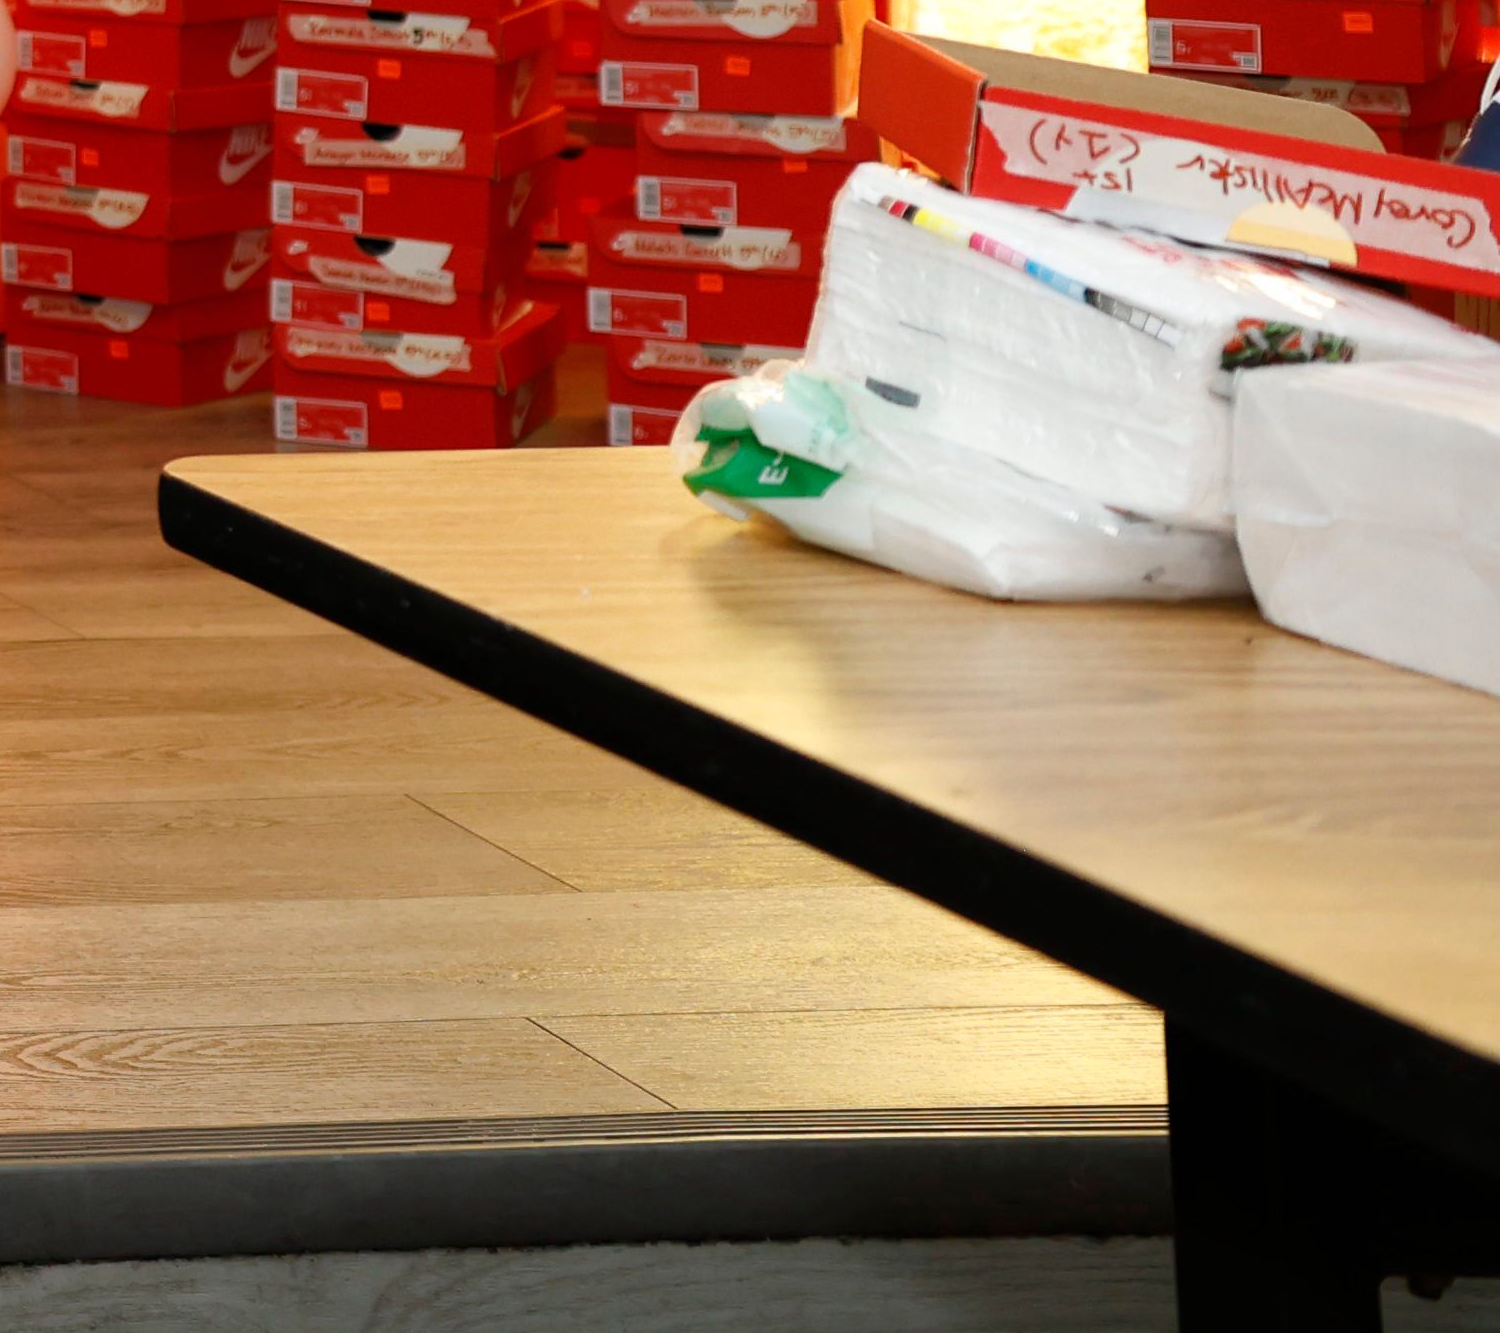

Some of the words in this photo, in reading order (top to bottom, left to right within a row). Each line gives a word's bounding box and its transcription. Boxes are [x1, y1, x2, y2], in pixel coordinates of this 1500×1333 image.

[1073, 167, 1134, 192] 1st
[1177, 153, 1363, 225] McAllister
[1372, 186, 1477, 250] Corey
